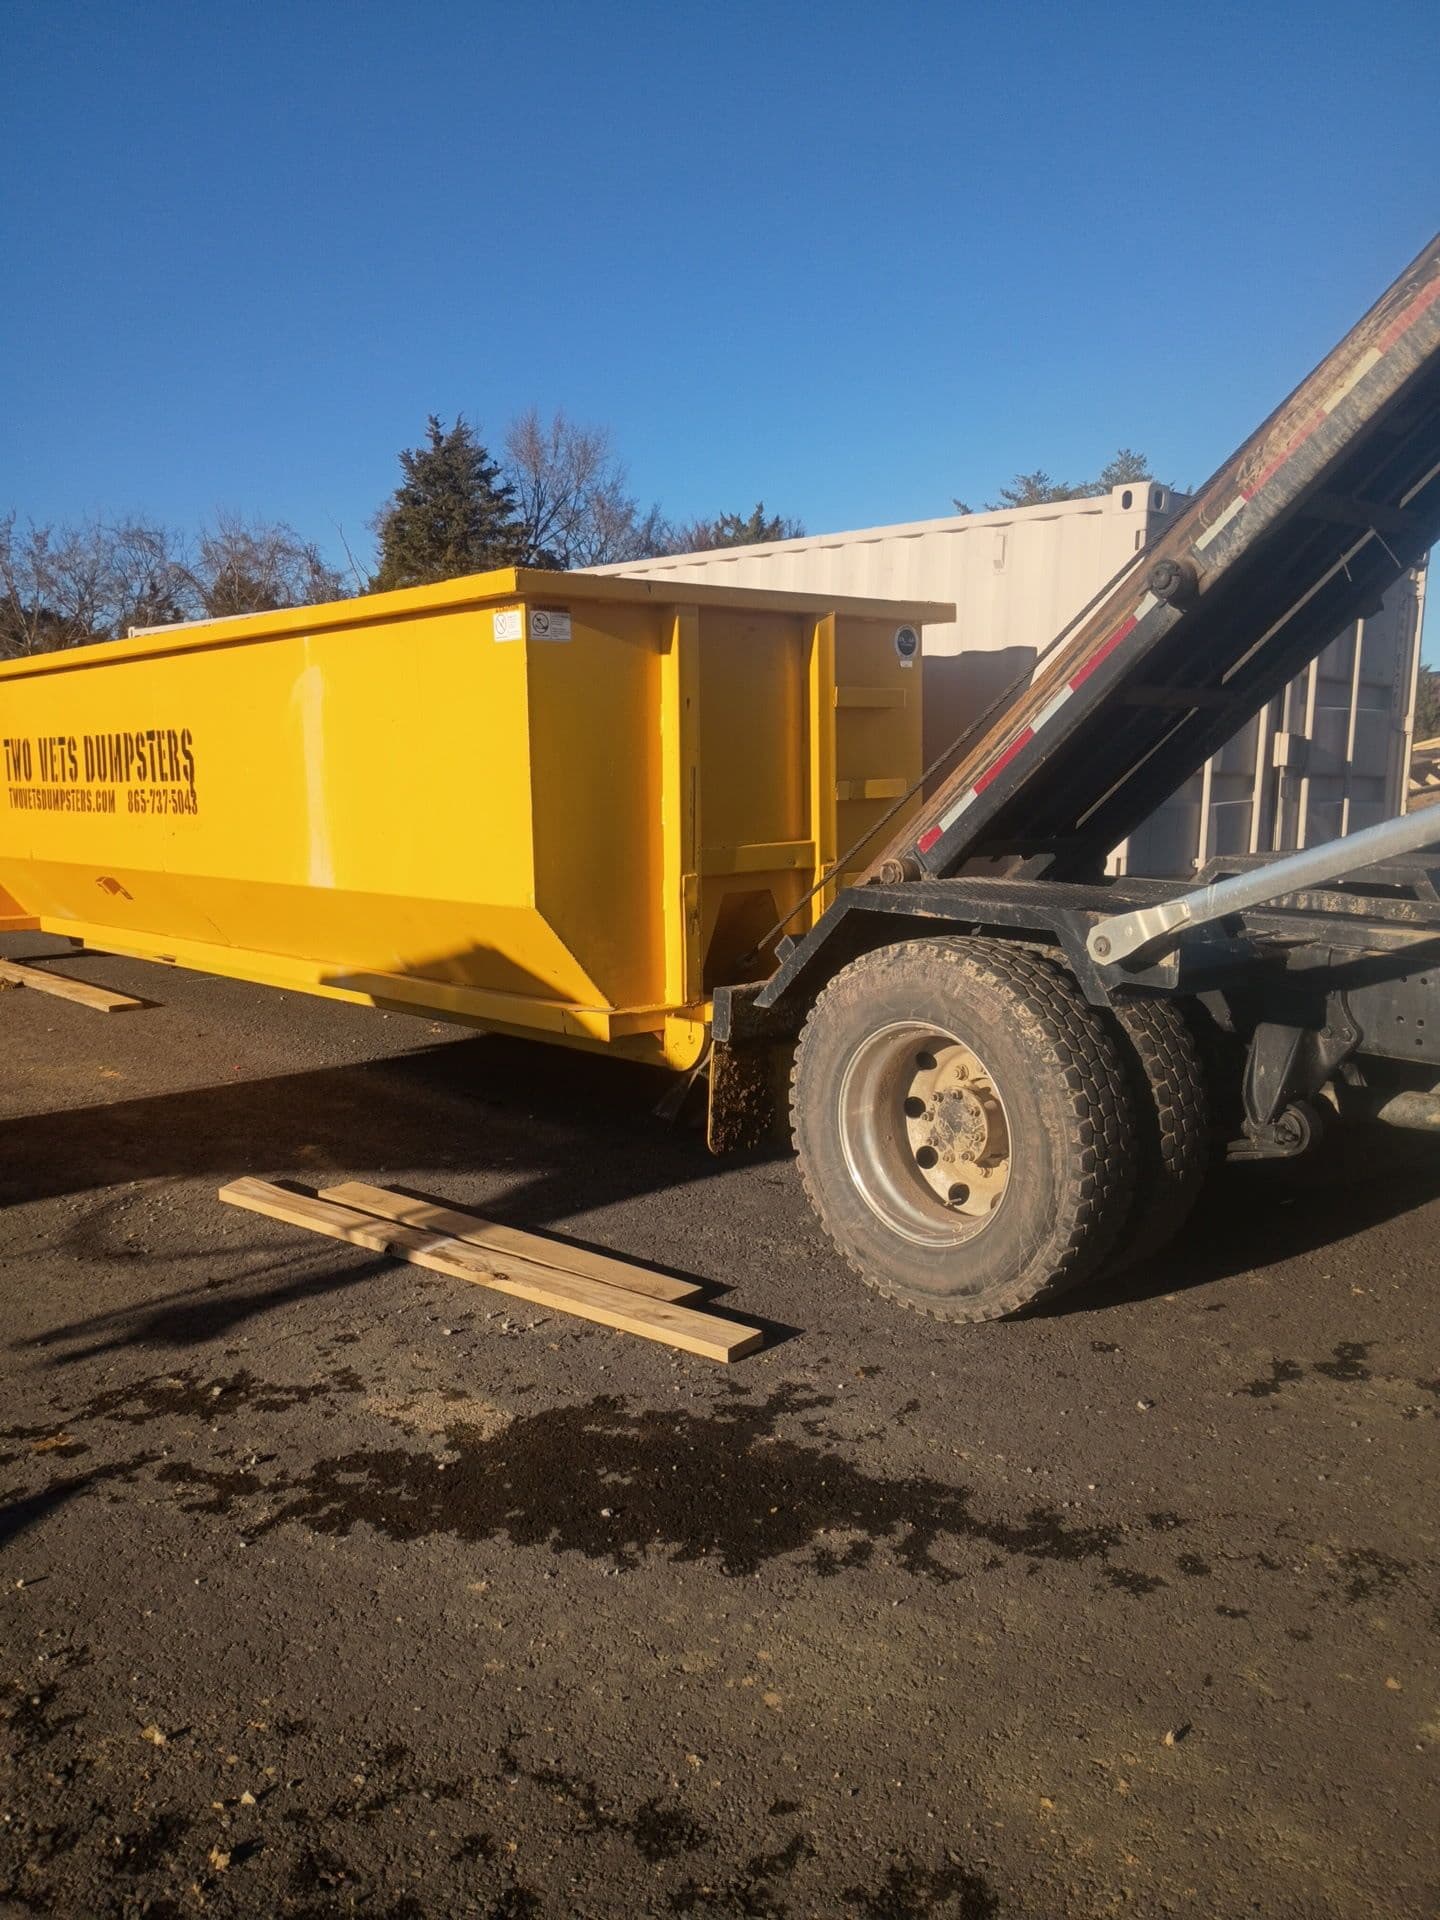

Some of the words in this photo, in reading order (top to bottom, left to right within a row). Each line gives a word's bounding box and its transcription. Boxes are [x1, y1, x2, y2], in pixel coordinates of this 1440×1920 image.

[4, 738, 32, 782] TWO
[39, 736, 78, 783] VETS
[84, 728, 195, 784] DUMPSTERS
[9, 788, 115, 813] TWOVETSDUMPSTERS.COM
